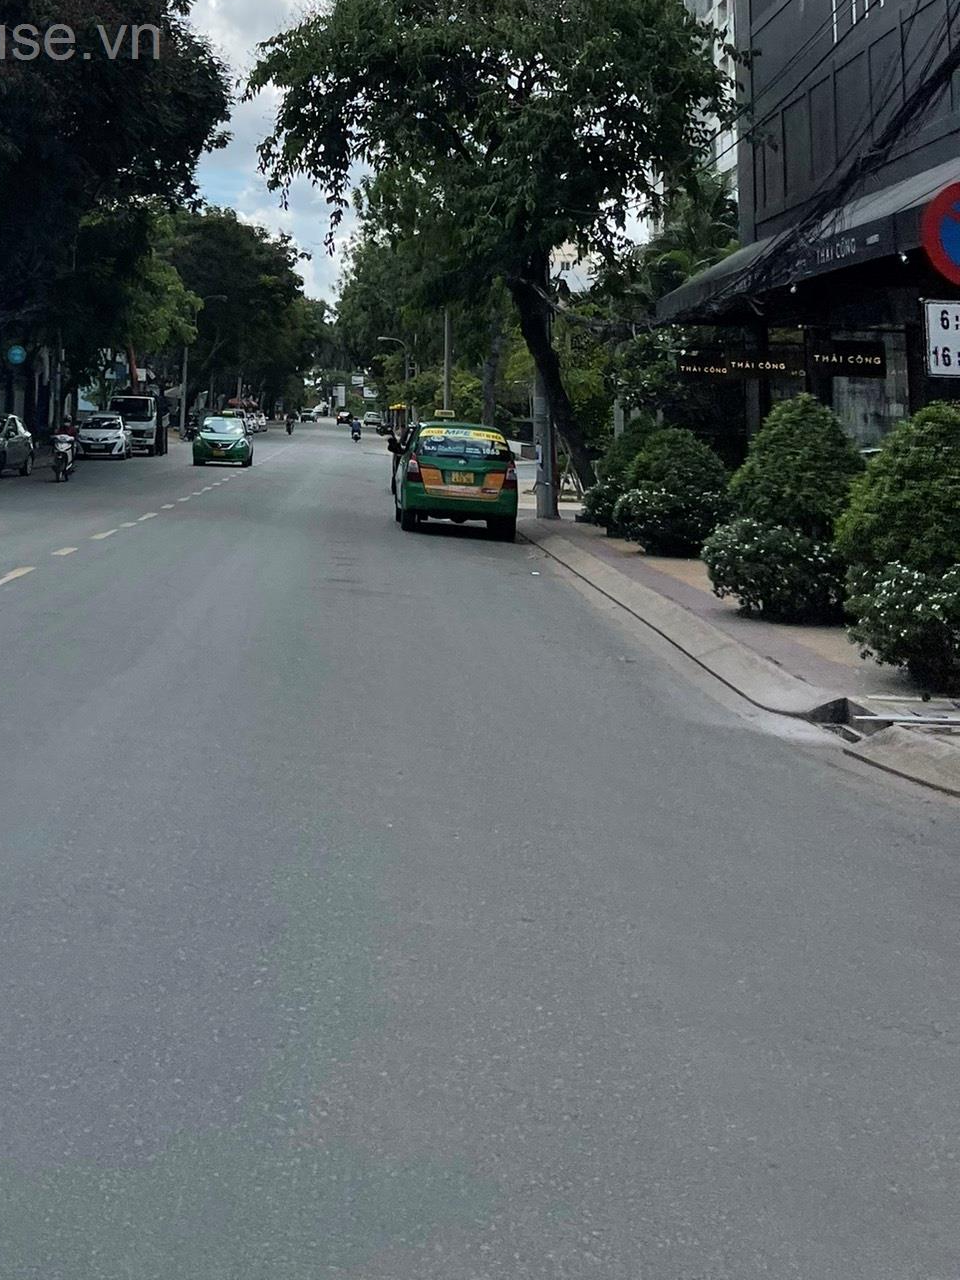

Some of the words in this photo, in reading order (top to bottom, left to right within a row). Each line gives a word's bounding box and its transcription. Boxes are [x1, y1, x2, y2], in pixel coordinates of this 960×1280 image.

[813, 354, 843, 364] THÁI
[847, 354, 881, 365] CÔNG
[703, 366, 727, 374] CÔNG
[758, 361, 786, 370] CÔNG
